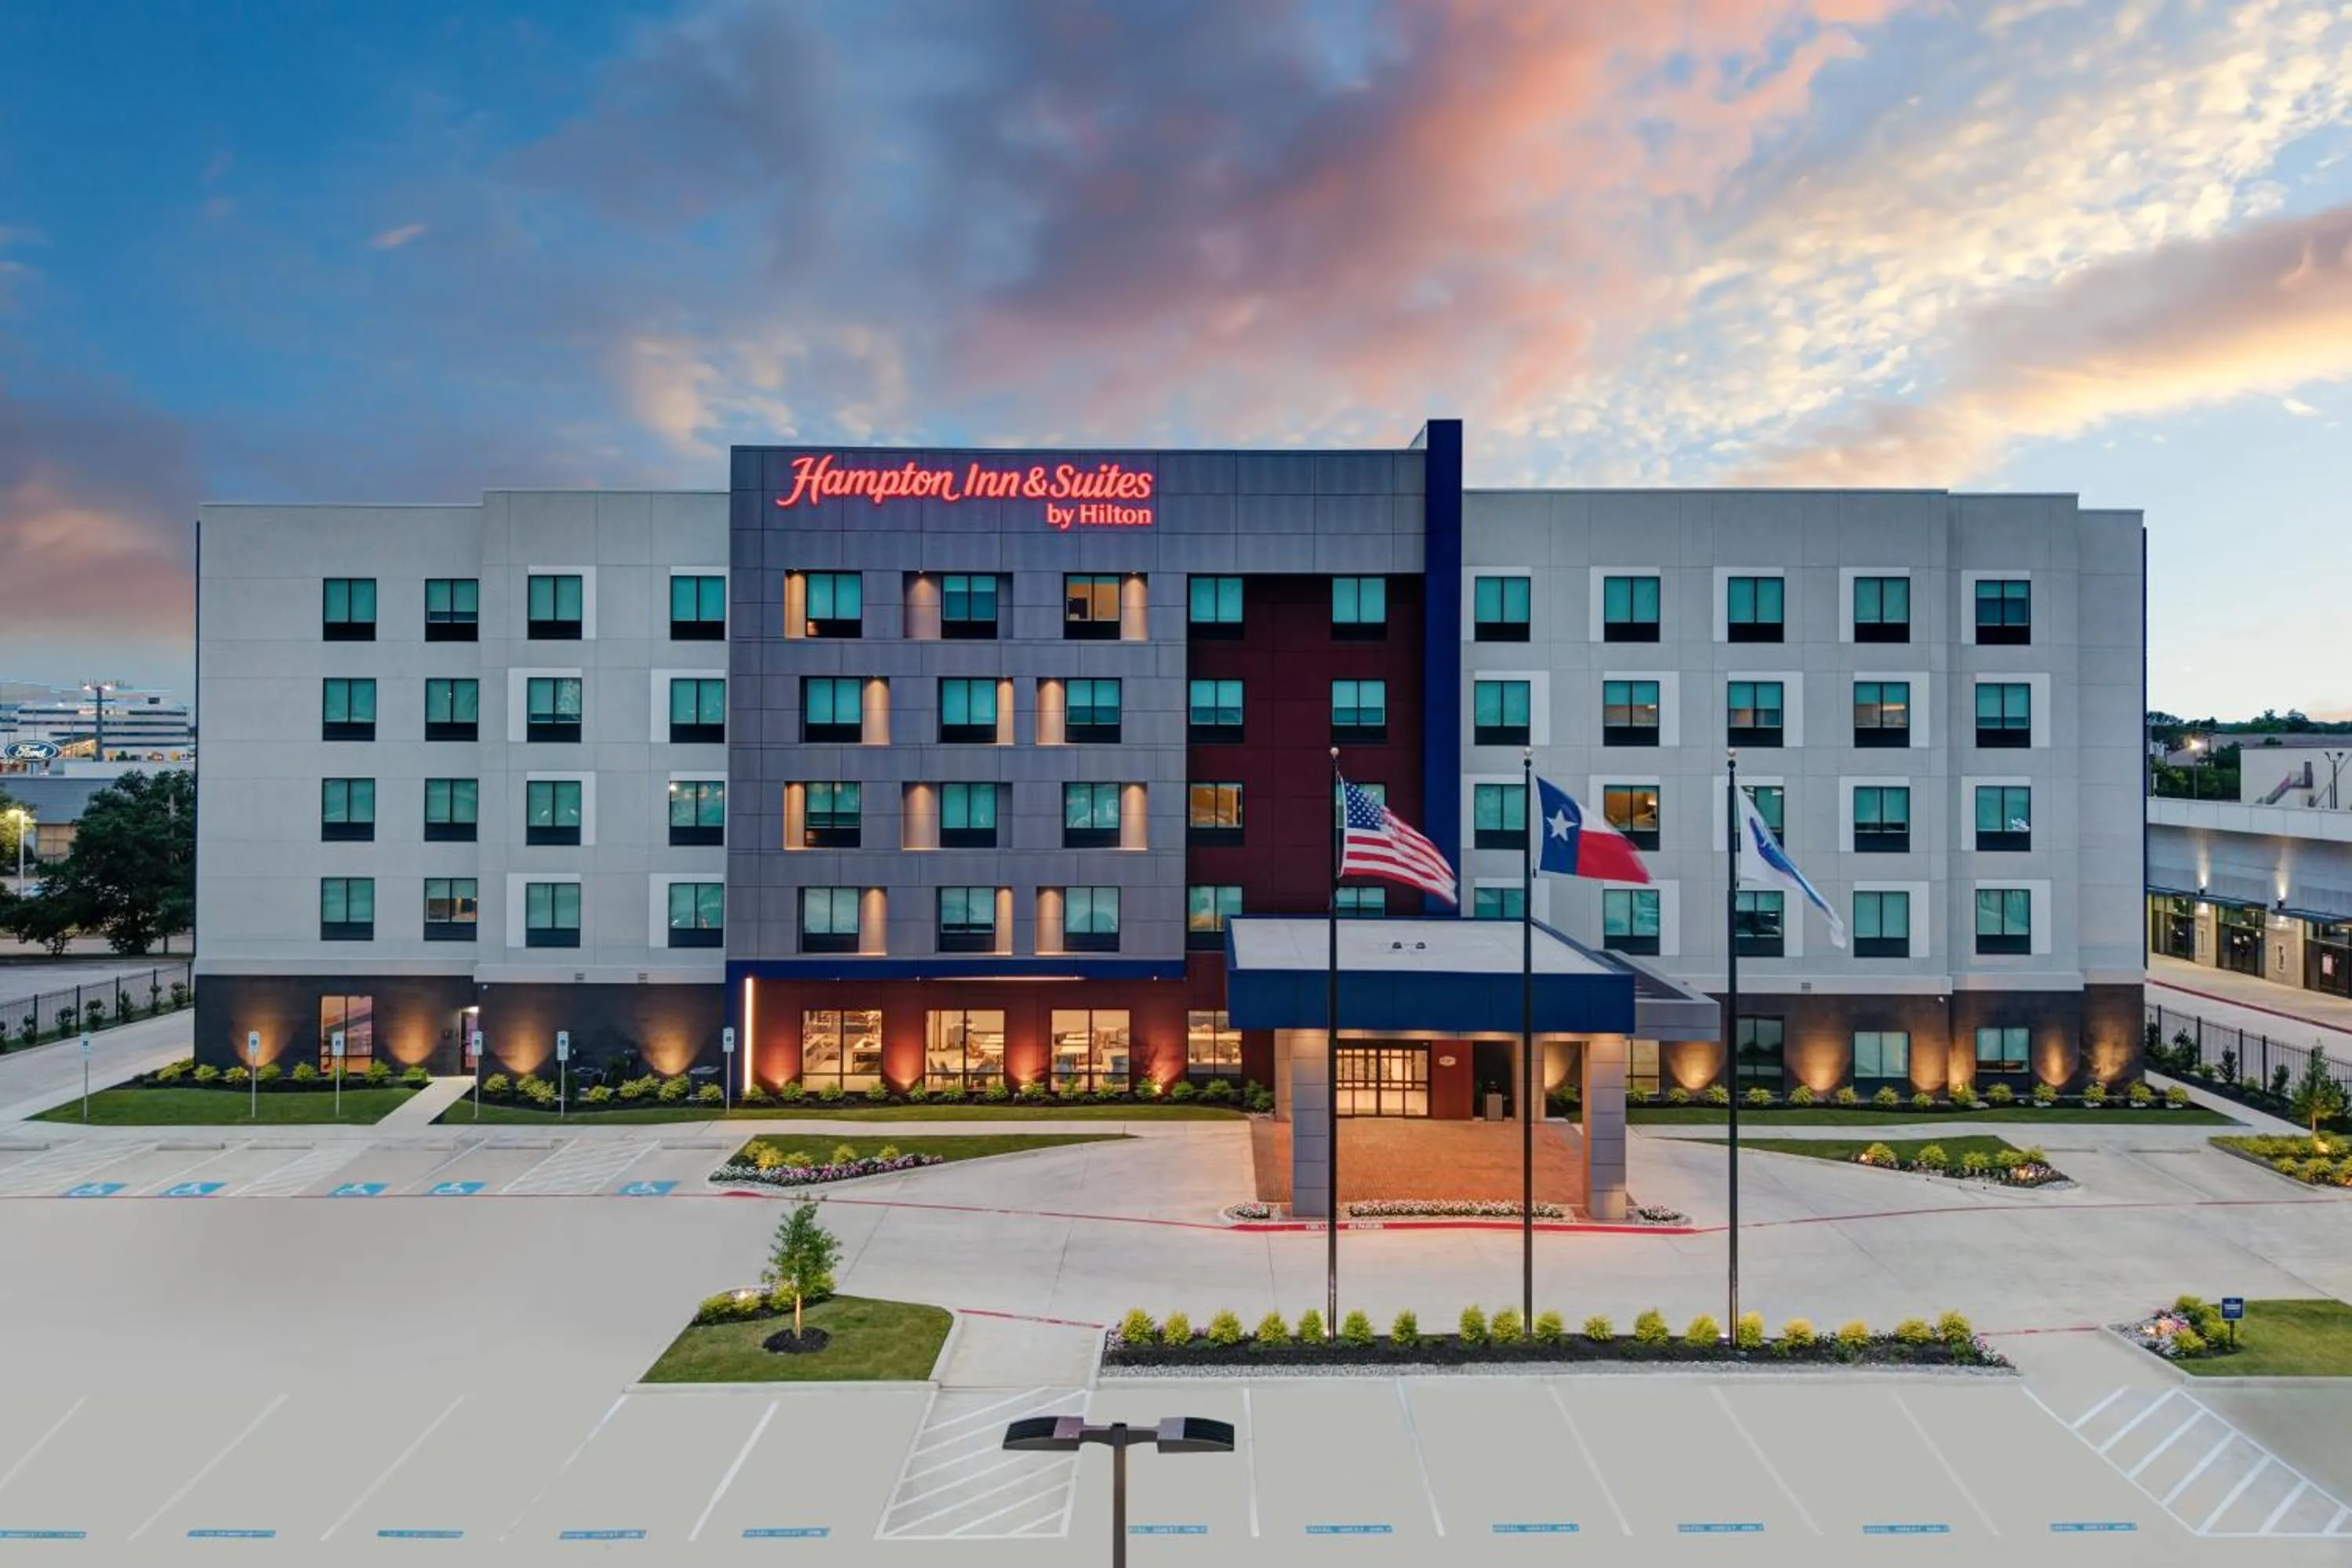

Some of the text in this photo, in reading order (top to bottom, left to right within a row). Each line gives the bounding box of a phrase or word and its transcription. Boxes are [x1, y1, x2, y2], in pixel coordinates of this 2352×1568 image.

[777, 455, 960, 506] Hampton
[964, 463, 1021, 498] Inn
[1049, 463, 1153, 499] Suites
[1047, 503, 1152, 529] by Hilton
[16, 744, 47, 759] Ford
